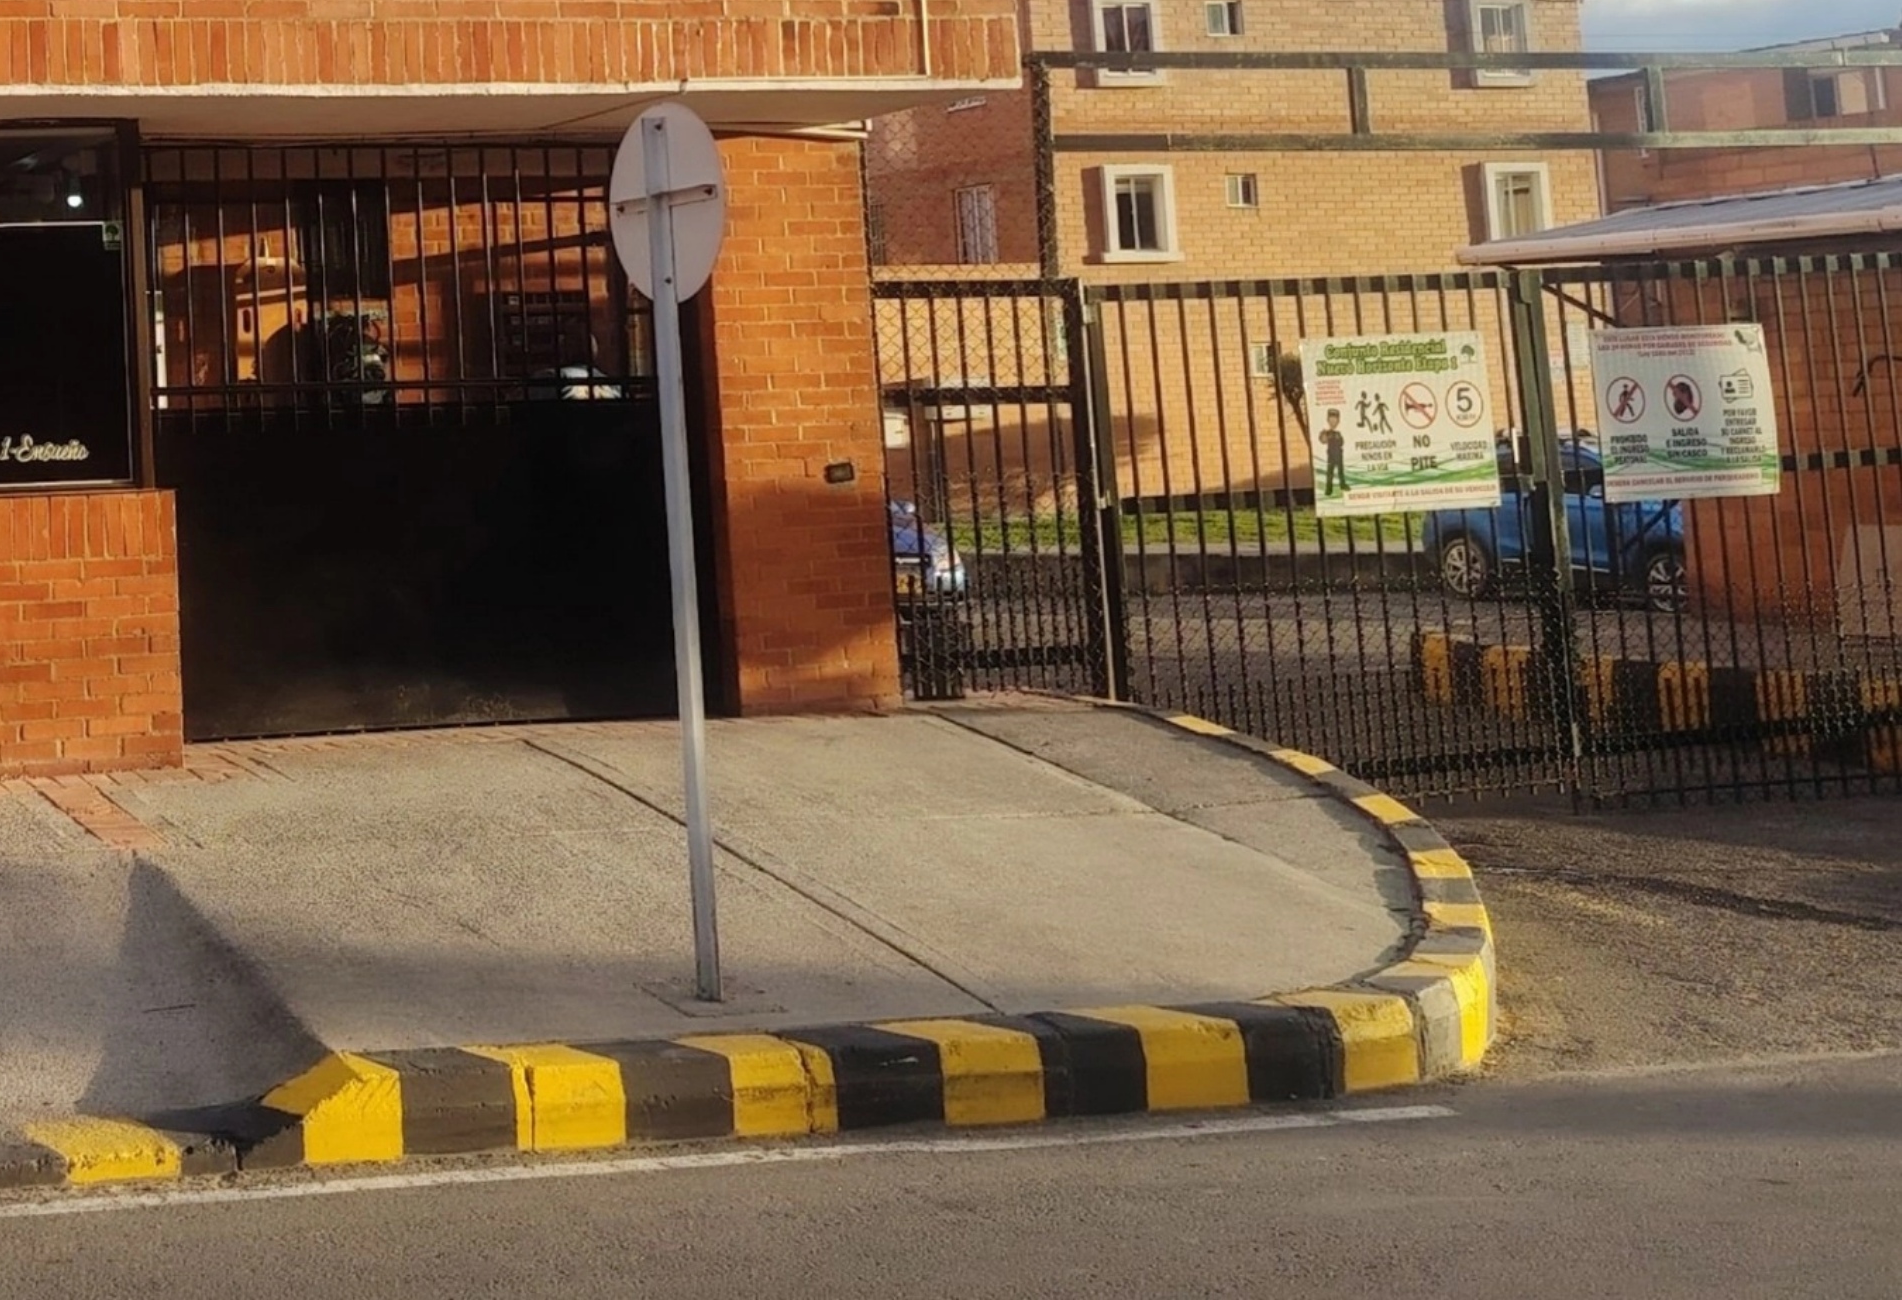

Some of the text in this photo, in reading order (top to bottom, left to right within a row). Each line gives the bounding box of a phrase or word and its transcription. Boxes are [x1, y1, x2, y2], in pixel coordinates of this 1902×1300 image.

[1324, 339, 1447, 361] Conjunto Residencial
[1316, 360, 1355, 377] Nuevo
[1355, 357, 1413, 375] Horizonte
[1414, 356, 1449, 374] Etapa
[1456, 387, 1473, 412] 5
[1671, 427, 1700, 437] SALIDA
[1413, 434, 1431, 448] NO
[1672, 438, 1708, 448] INGRESO
[1682, 449, 1708, 458] CASCO
[1411, 455, 1439, 471] PITE
